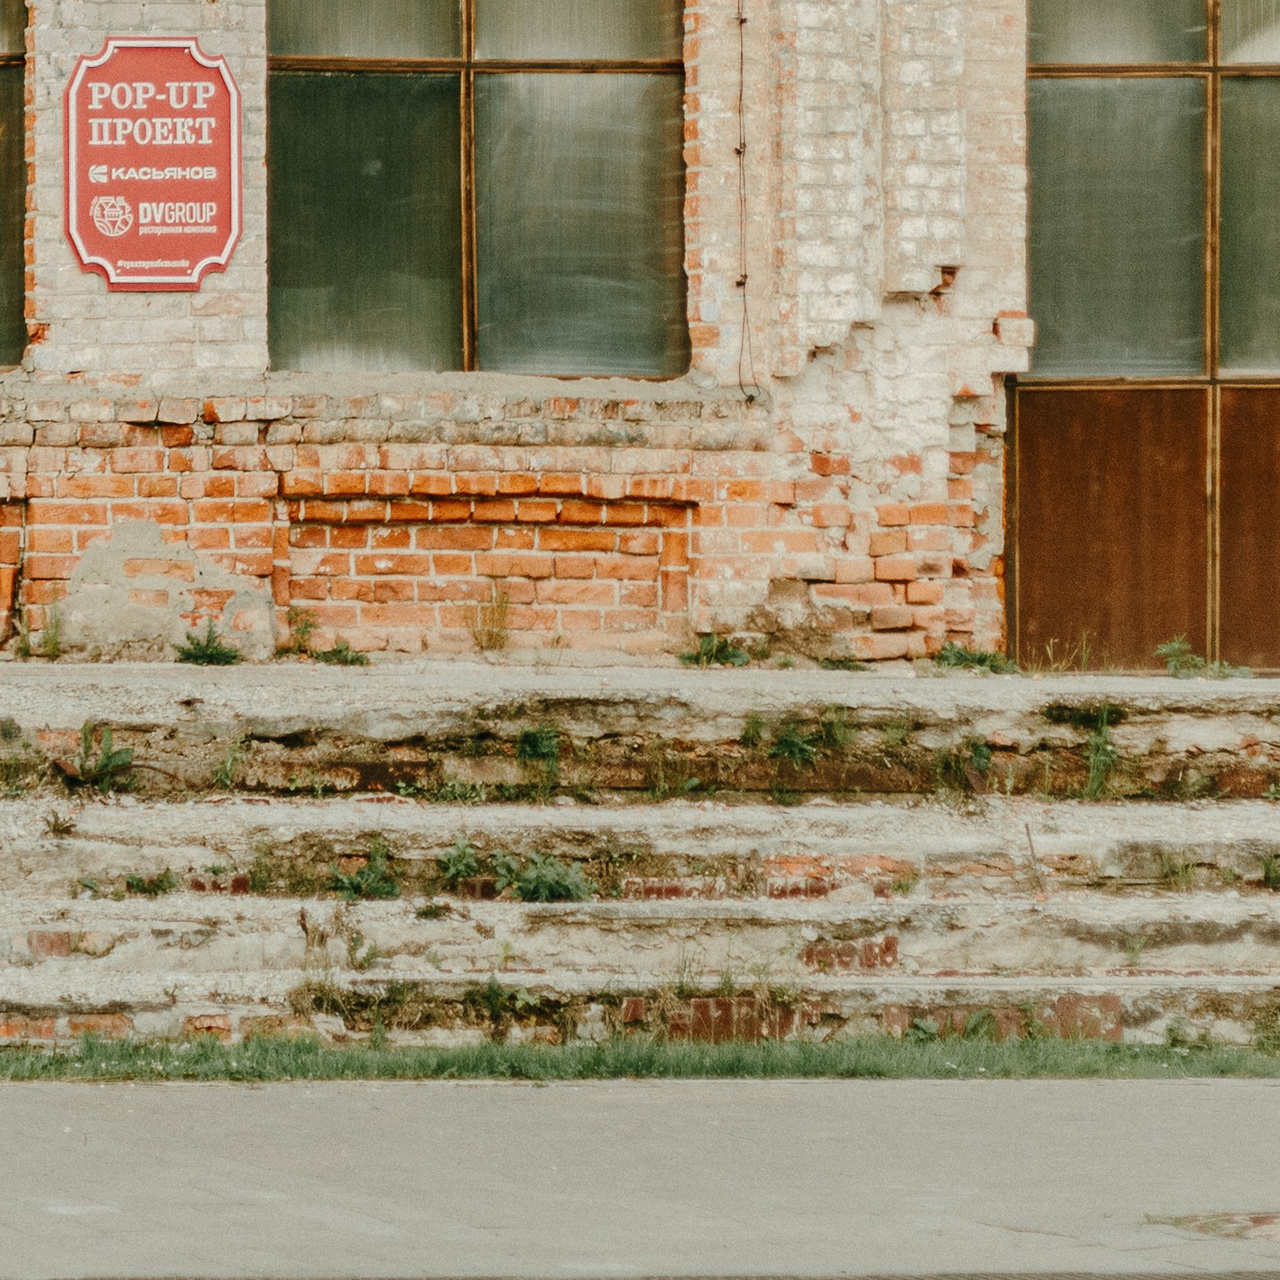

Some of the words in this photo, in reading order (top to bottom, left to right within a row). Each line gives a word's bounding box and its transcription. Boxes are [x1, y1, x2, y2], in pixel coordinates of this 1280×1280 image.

[87, 81, 217, 110] POP-UP
[88, 117, 217, 146] ПРОЕКТ
[111, 166, 218, 181] КАСЬЯНОВ
[138, 201, 218, 224] DVGROUP
